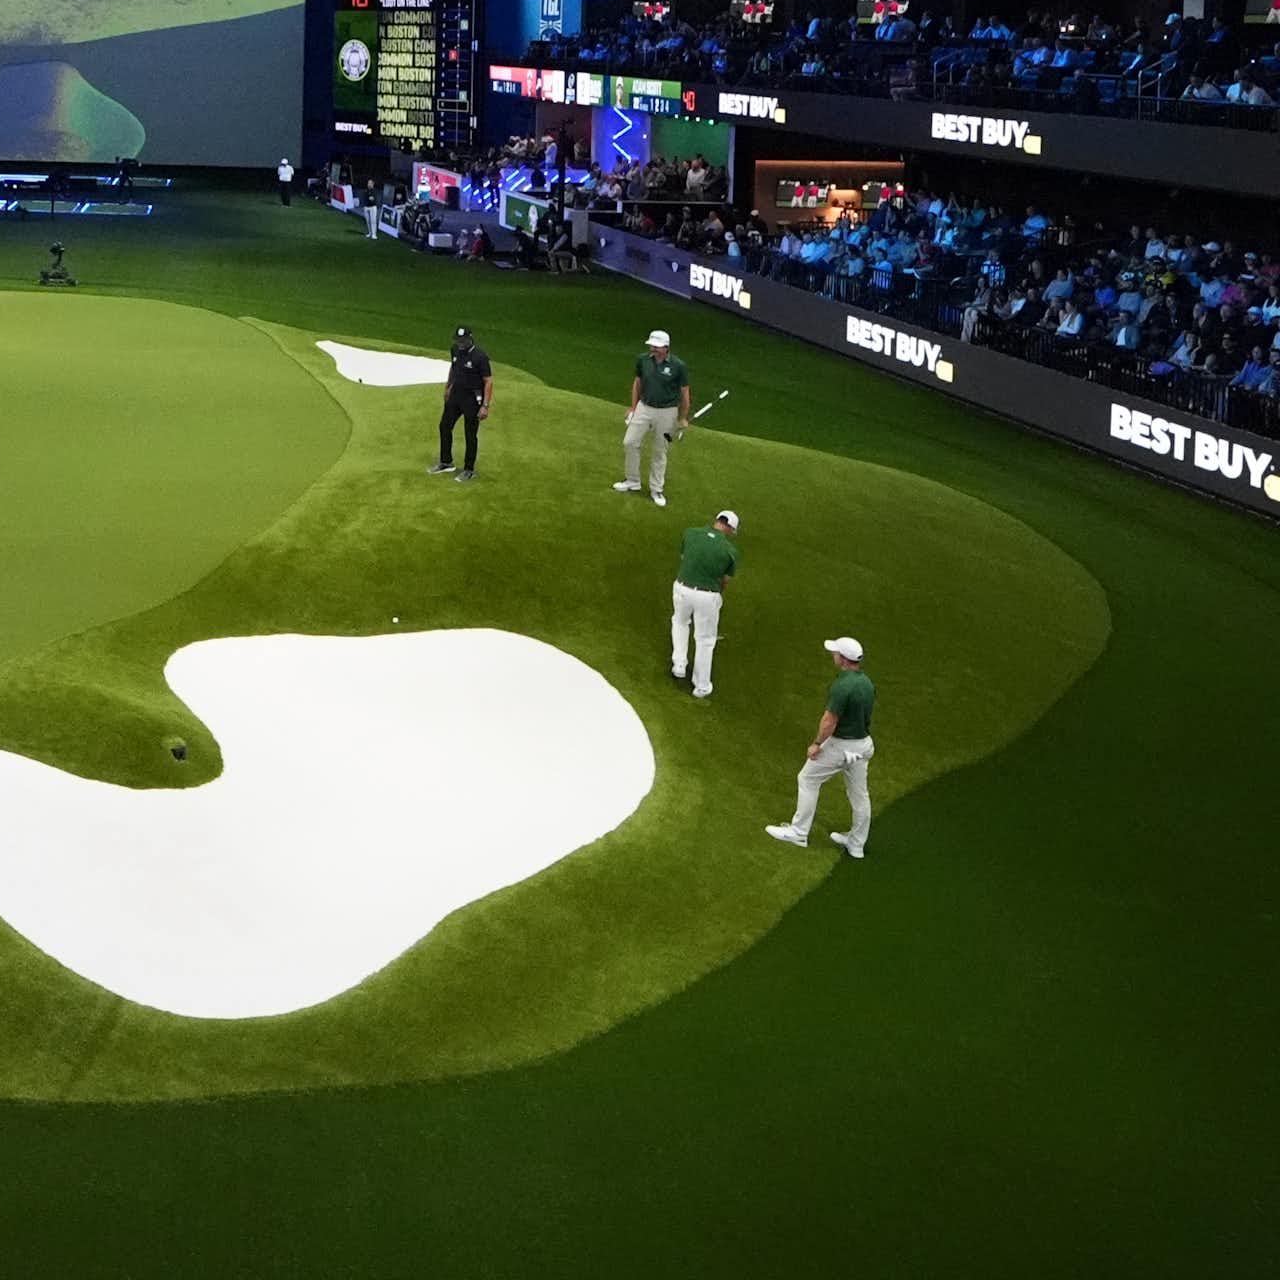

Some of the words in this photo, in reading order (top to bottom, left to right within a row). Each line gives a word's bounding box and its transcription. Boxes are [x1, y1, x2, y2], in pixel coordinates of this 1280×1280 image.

[394, 11, 432, 24] COMMON
[387, 25, 420, 38] BOSTON
[381, 40, 413, 52] BOSTON
[398, 68, 431, 82] BOSTON
[393, 82, 431, 95] COMMON
[399, 96, 432, 110] BOSTON
[683, 91, 695, 112] 40
[719, 93, 750, 116] BEST
[749, 95, 778, 119] BUY
[335, 122, 352, 132] BEST
[353, 123, 368, 133] BUY
[380, 123, 417, 137] COMMON
[931, 113, 981, 143] BEST
[981, 118, 1029, 149] BUY
[690, 264, 713, 291] EST
[712, 271, 743, 302] BUY
[846, 315, 895, 356] BEST
[896, 331, 941, 372] BUY
[1109, 403, 1191, 461] BEST
[1194, 430, 1273, 489] BUY
